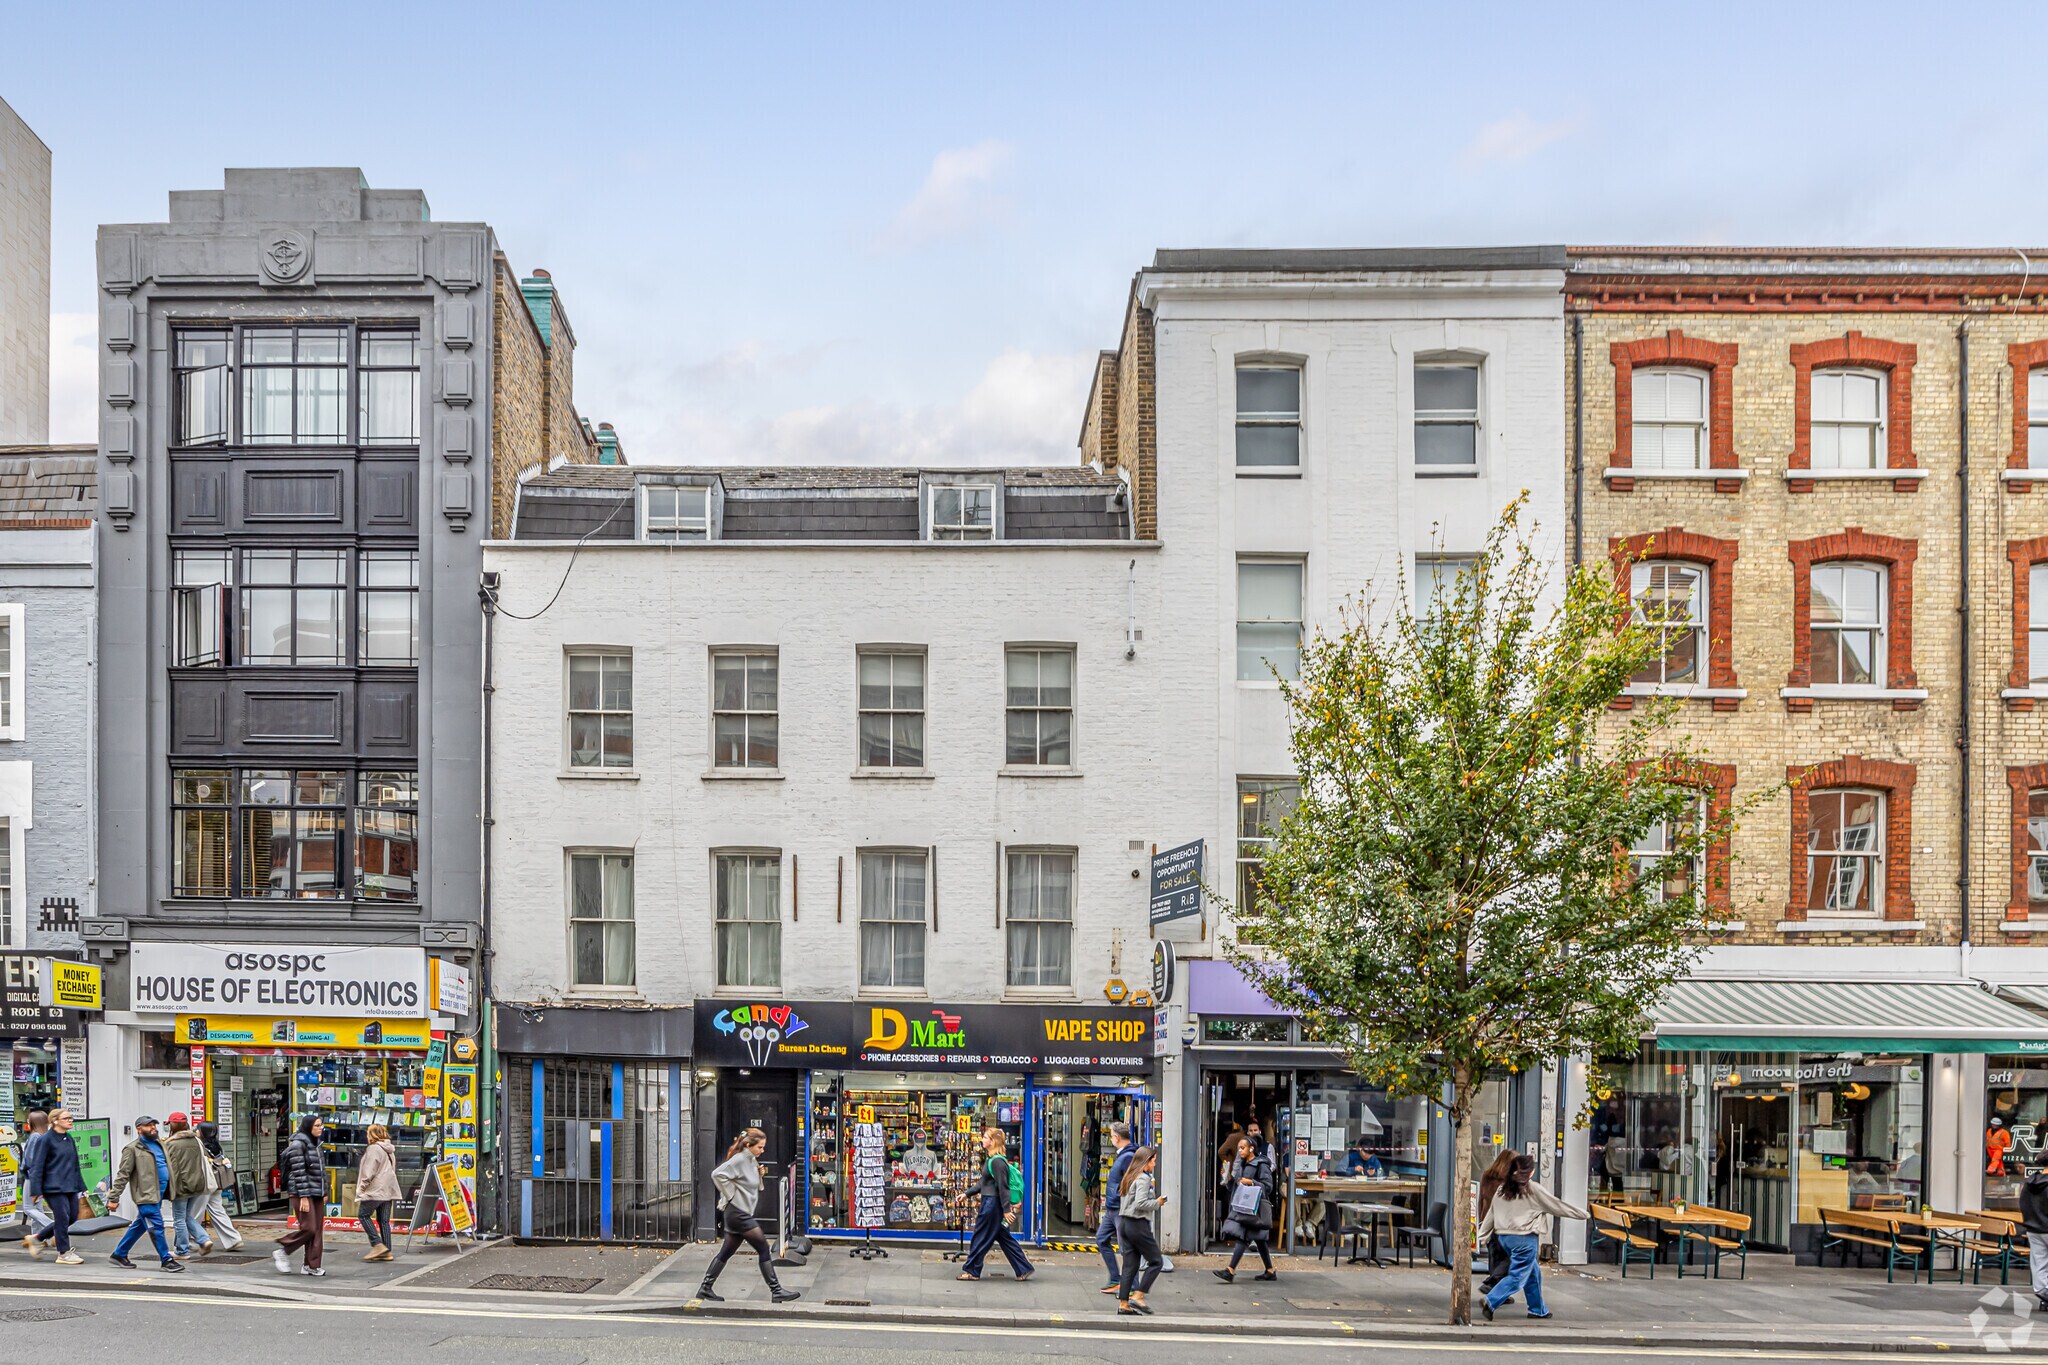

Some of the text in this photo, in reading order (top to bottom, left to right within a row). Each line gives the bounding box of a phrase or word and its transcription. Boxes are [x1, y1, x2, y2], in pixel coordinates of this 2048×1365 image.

[1153, 845, 1199, 868] PRIME FREEHOLD
[1156, 858, 1195, 878] OPPORTUNITY
[1159, 873, 1191, 890] FOR SALE
[225, 952, 326, 978] asospc
[63, 968, 91, 981] MONEY
[57, 980, 97, 994] EXCHANGE
[136, 976, 418, 1007] HOUSE OF ELECTRONICS
[7, 992, 31, 1002] DIGITAL
[11, 1007, 40, 1017] RØDE
[365, 1008, 418, 1016] info@asosopc.com
[863, 1007, 966, 1051] D Mart
[1044, 1019, 1146, 1042] VAPE SHOP
[210, 1032, 254, 1040] DESIGN-EDITING
[779, 1044, 847, 1055] Bureau De Chang
[867, 1053, 1144, 1066] PHONE ACCESSORIES REPAIRS TOBACCO LUGGAGES SOUVENIRS
[161, 1079, 172, 1087] 49
[860, 1107, 872, 1121] £1
[958, 1117, 968, 1131] £1
[908, 1154, 931, 1165] LONDON
[324, 1219, 351, 1232] Premier
